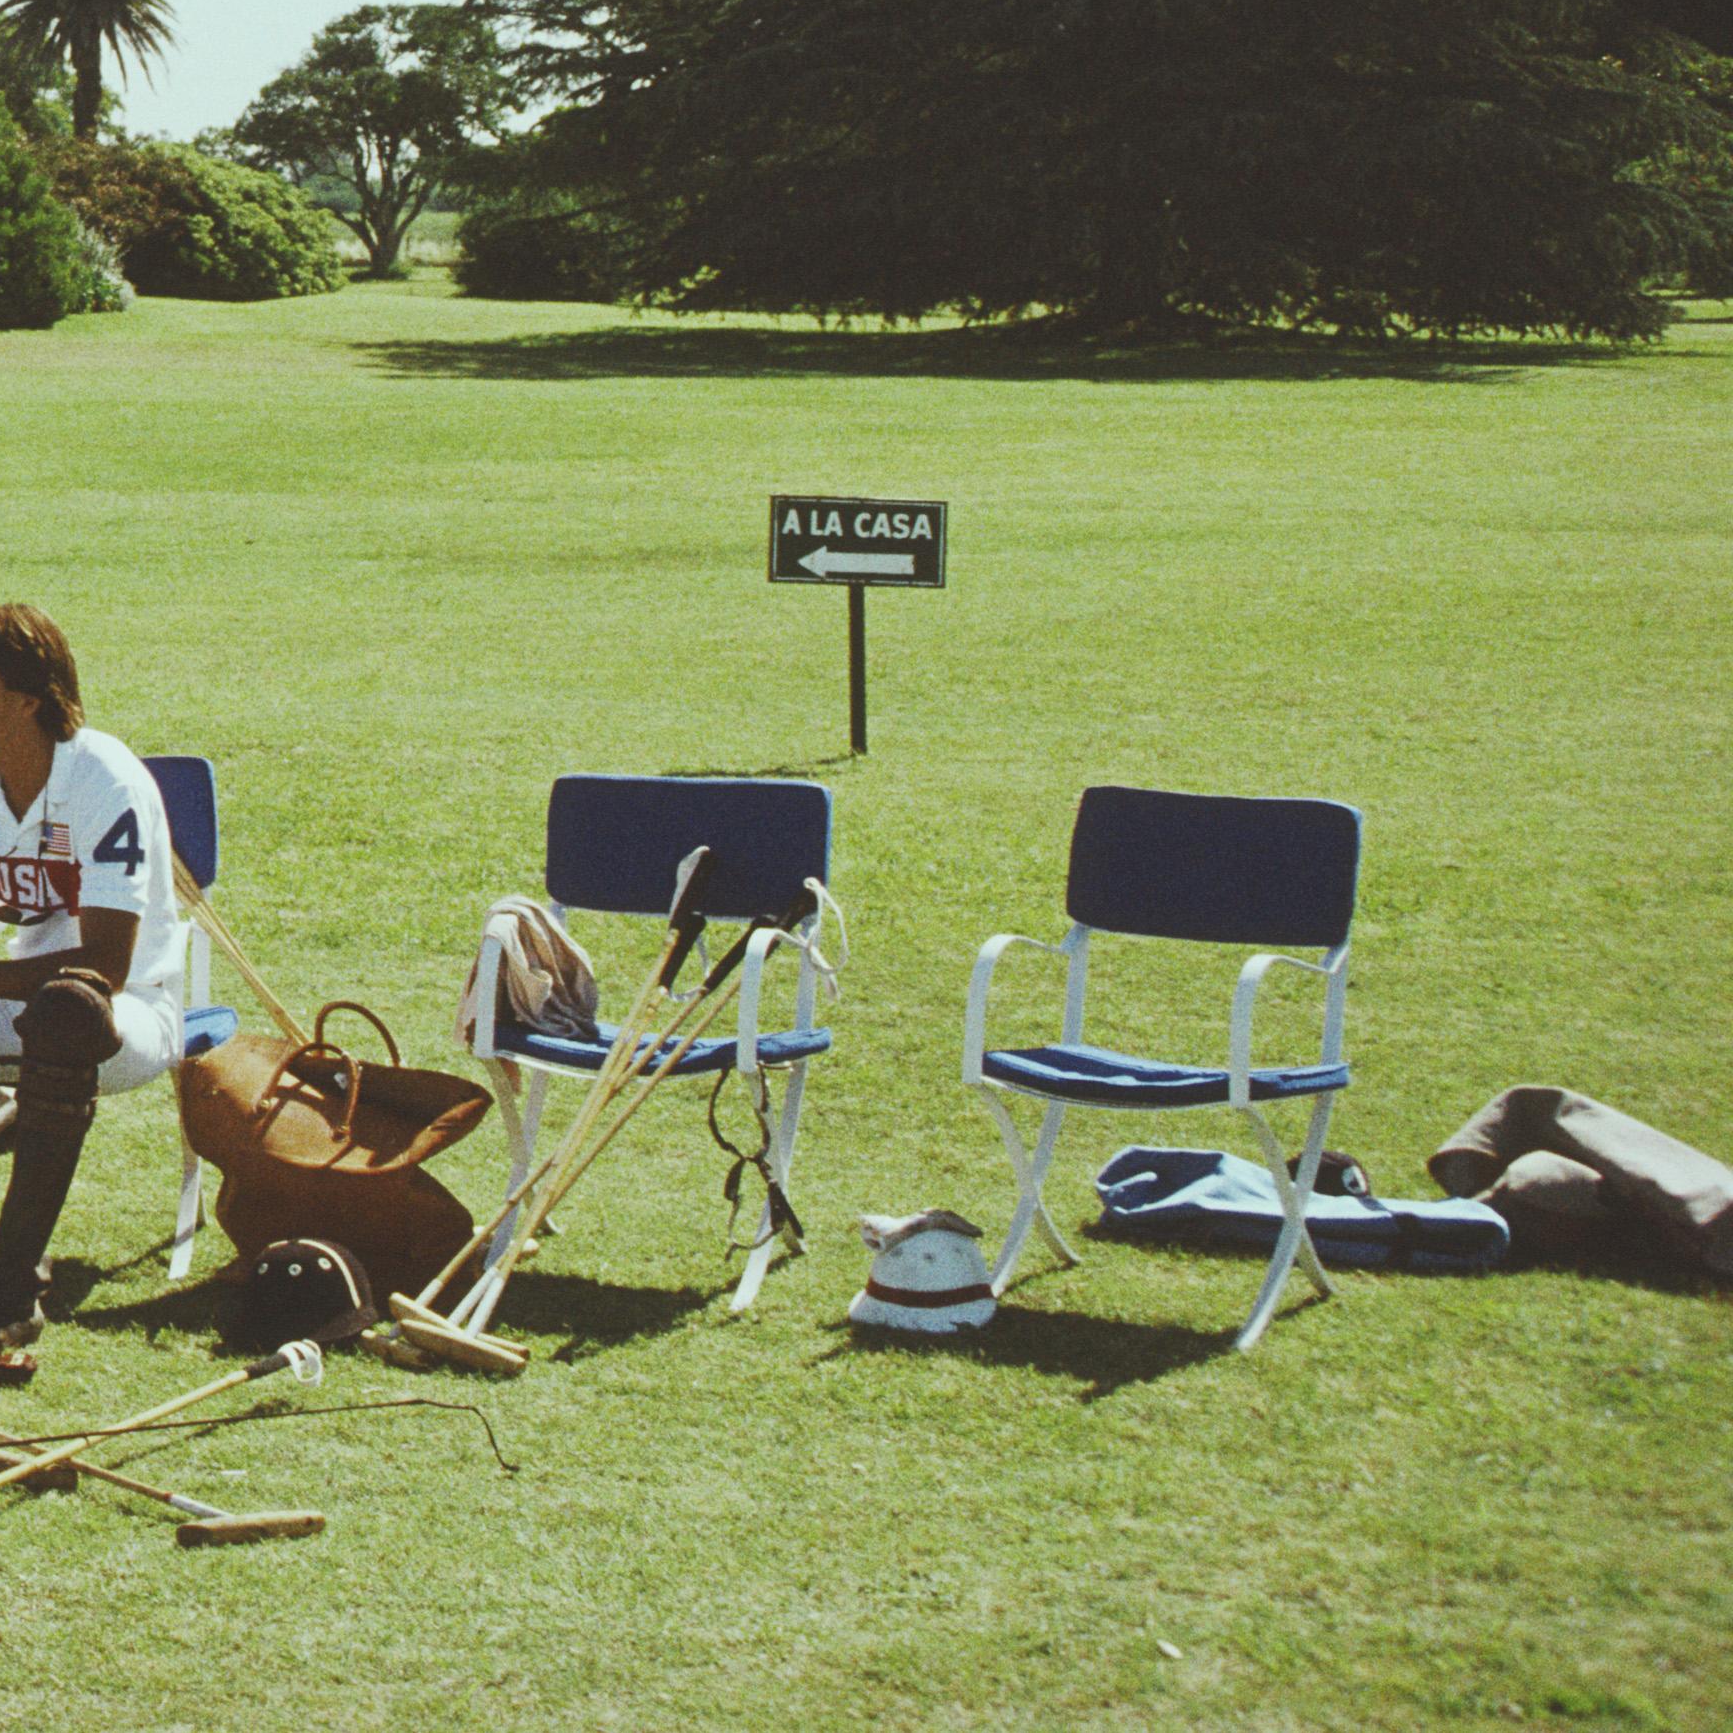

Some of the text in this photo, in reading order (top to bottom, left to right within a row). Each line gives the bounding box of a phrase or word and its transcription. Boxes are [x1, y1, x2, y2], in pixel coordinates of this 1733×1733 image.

[781, 507, 934, 541] A LA CASA
[92, 807, 146, 877] 4
